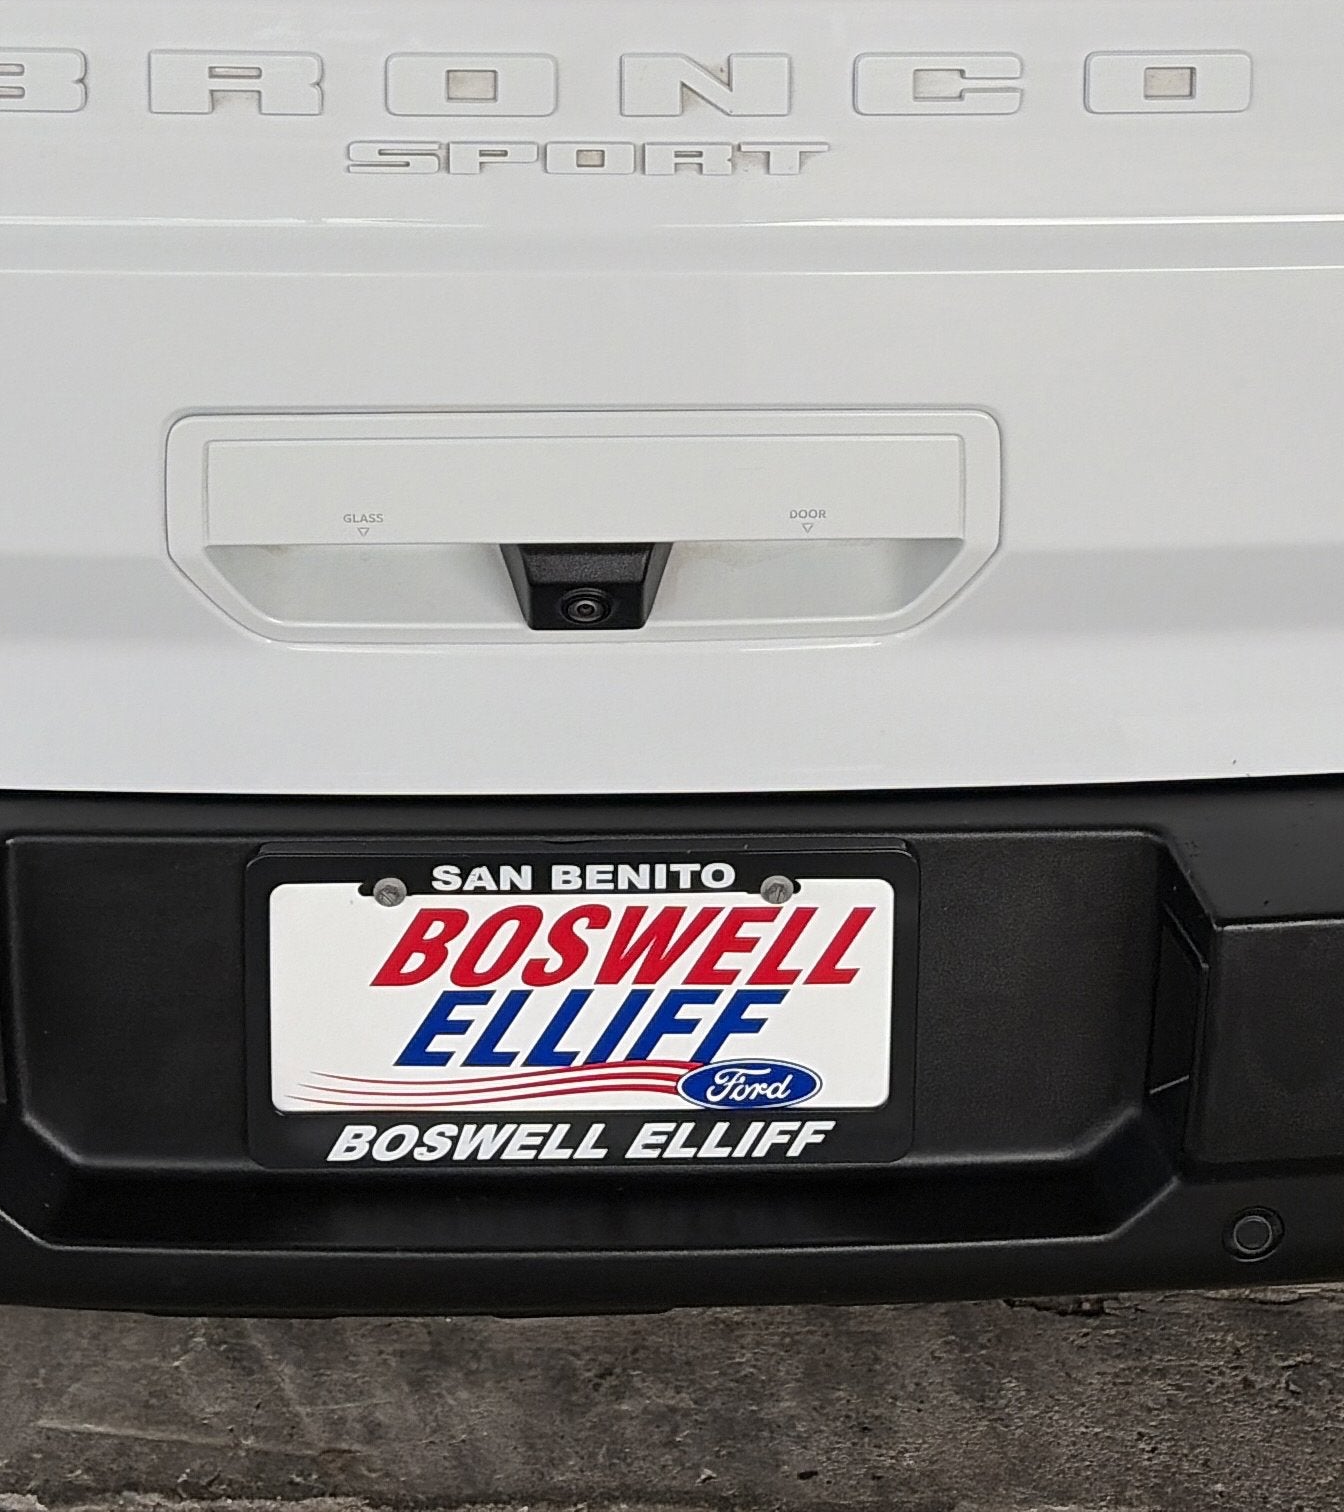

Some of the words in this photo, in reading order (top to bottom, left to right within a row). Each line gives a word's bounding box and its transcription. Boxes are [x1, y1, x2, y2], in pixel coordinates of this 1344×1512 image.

[346, 140, 831, 177] SPORT
[342, 513, 384, 524] GLASS
[789, 509, 827, 520] DOOR
[430, 863, 534, 892] SAN
[550, 861, 737, 891] BENITO
[369, 903, 877, 987] BOSWELL
[392, 988, 791, 1068] ELLIFF
[705, 1065, 794, 1102] Ford
[325, 1121, 611, 1162] BOSWELL
[626, 1119, 836, 1161] ELLIFF
